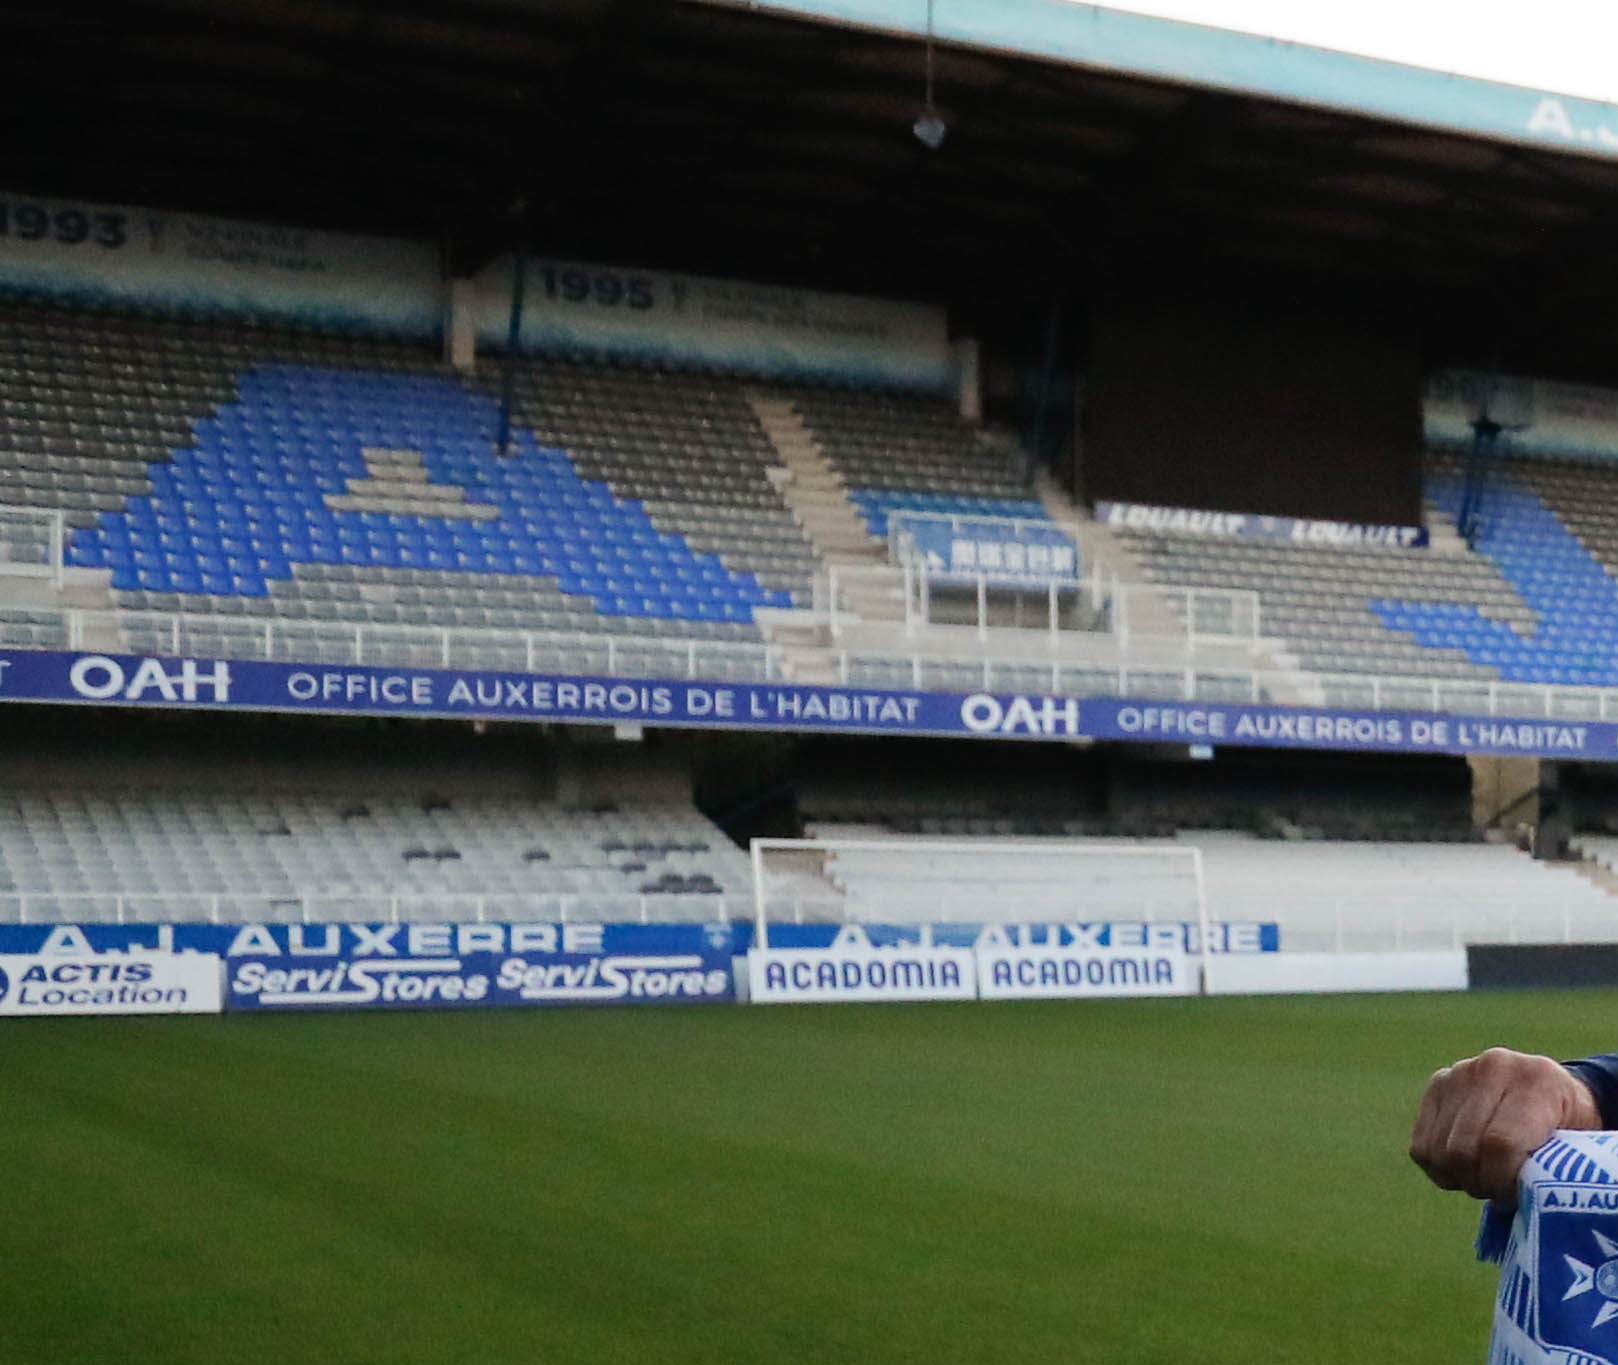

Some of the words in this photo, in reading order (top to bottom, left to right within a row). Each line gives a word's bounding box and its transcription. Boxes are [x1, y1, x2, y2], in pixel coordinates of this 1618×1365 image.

[0, 202, 126, 248] 1993
[545, 267, 653, 309] 1995
[69, 655, 230, 702] OAH
[287, 671, 433, 705] OFFICE
[447, 678, 673, 715] AUXERROIS
[686, 688, 735, 717] DE
[749, 690, 920, 723] L'HABITAT
[960, 694, 1080, 735] OAH
[1117, 707, 1225, 736] OFFICE
[1235, 713, 1402, 744] AUXERROIS
[1411, 720, 1448, 745] DE
[1457, 722, 1587, 750] L'HABITAT
[227, 923, 603, 956] AUXERRE
[20, 963, 153, 984] ACTIS
[233, 955, 489, 1004] ServiStores
[498, 955, 728, 1000] ServiStores
[766, 960, 961, 989] ACADOMIA
[992, 957, 1173, 986] ACADOMIA
[18, 984, 187, 1006] Location
